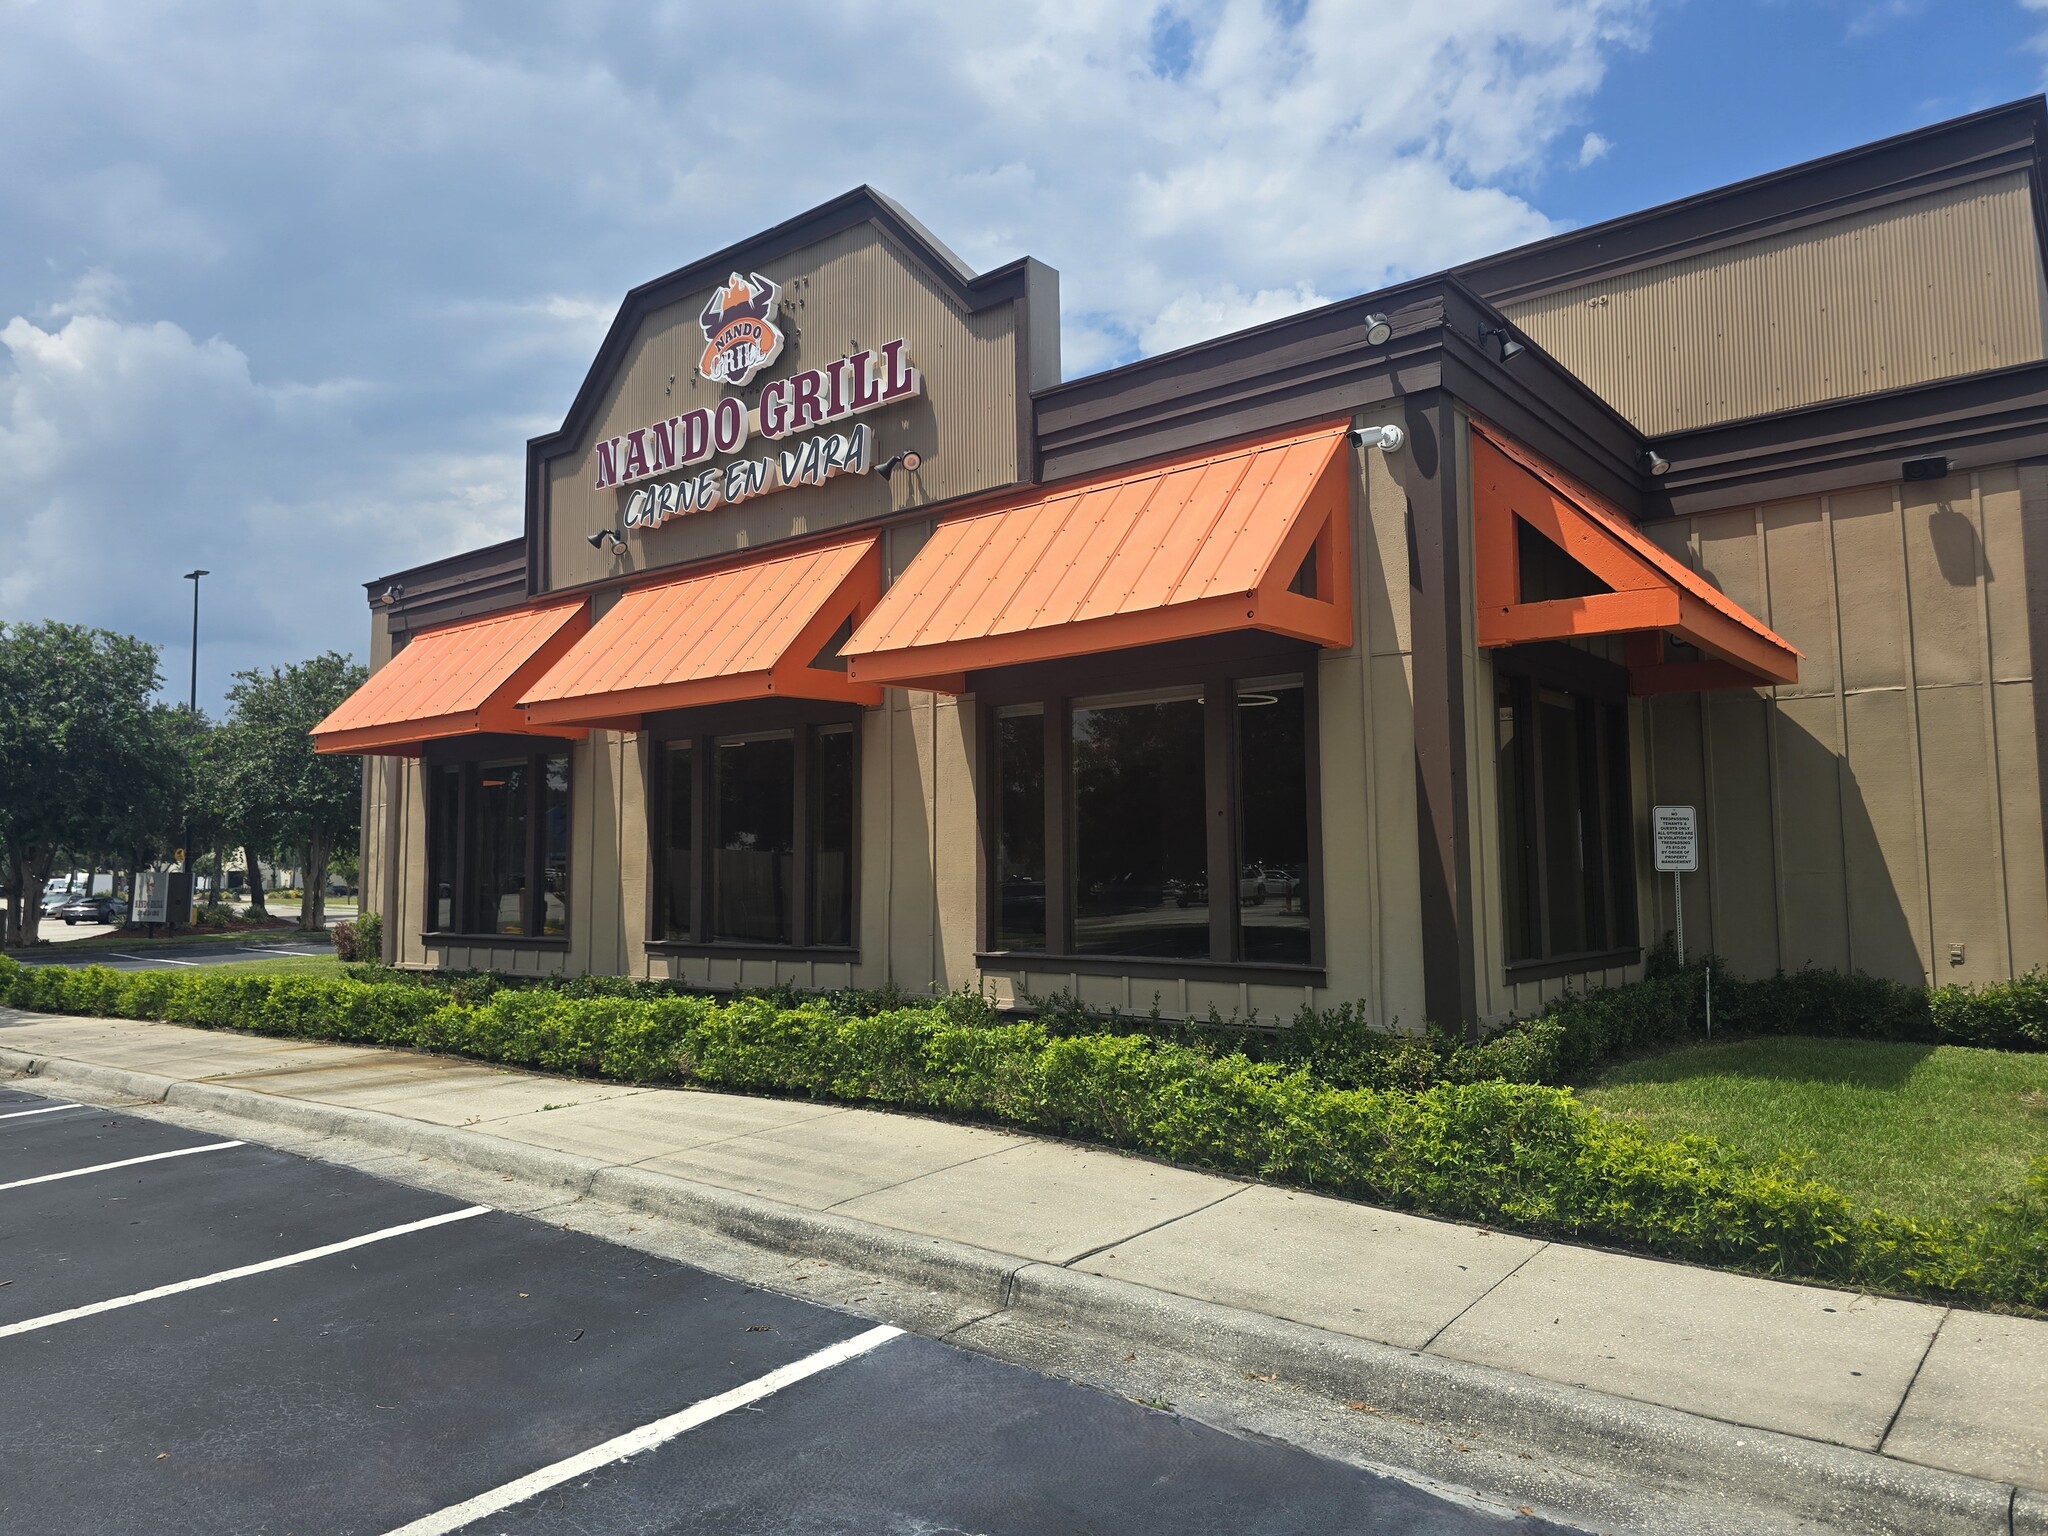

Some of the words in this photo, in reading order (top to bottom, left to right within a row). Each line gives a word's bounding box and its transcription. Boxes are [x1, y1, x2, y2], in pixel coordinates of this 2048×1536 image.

[711, 339, 767, 379] GRILL
[714, 322, 762, 353] NANDO
[595, 397, 745, 490] NANDO
[759, 338, 917, 440] GRILL
[624, 469, 723, 529] CARNE
[725, 457, 773, 504] EN
[779, 423, 871, 488] VARA
